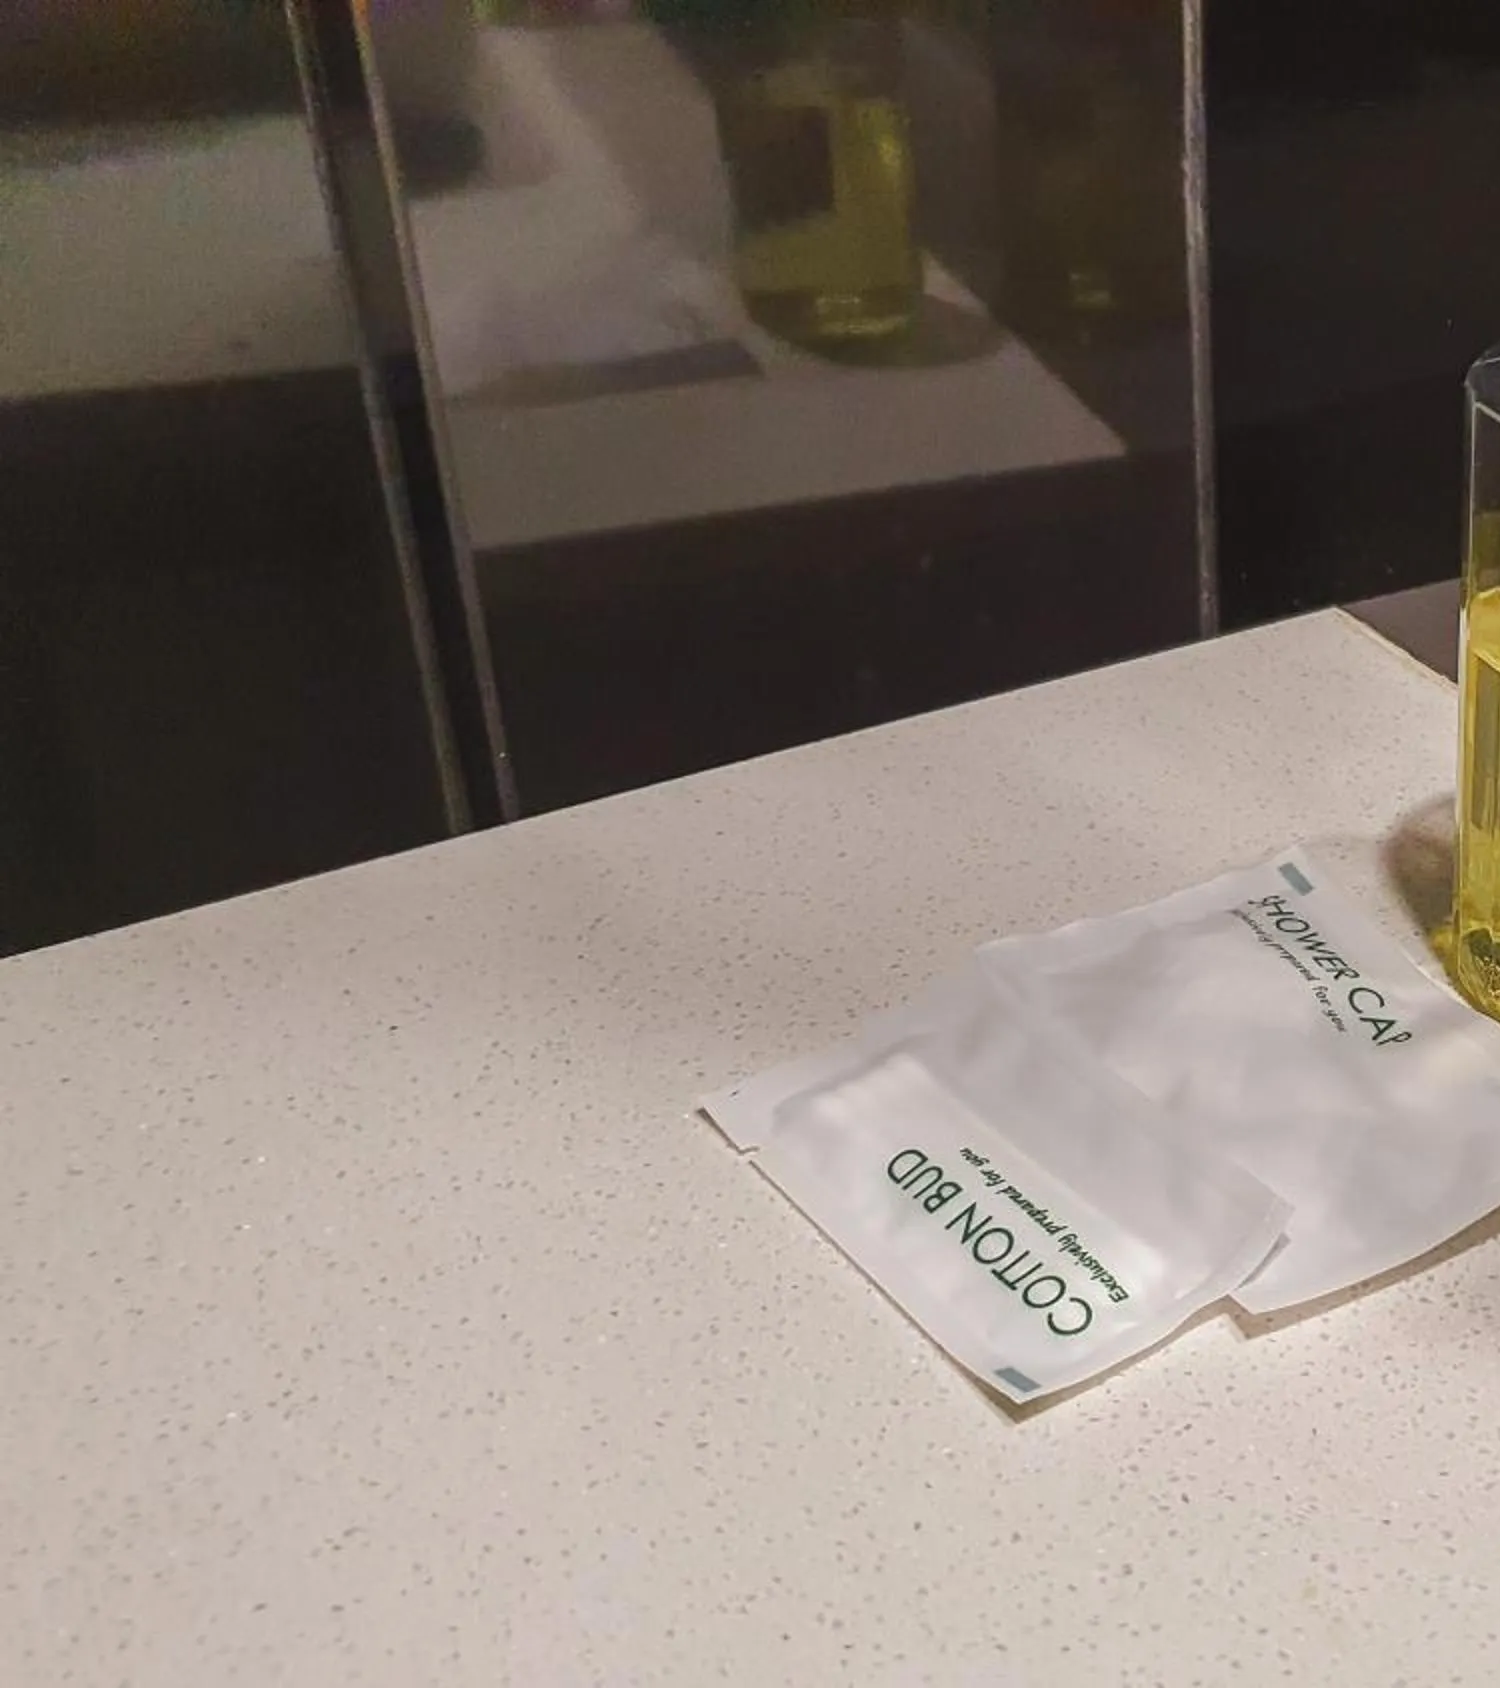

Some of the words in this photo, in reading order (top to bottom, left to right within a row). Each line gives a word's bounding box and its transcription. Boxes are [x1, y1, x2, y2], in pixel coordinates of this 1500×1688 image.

[1248, 895, 1360, 981] SHOWER
[1348, 987, 1412, 1046] CAP
[1312, 986, 1332, 1006] for
[887, 1148, 963, 1214] BUD
[960, 1147, 990, 1167] you
[980, 1169, 1006, 1187] for
[995, 1186, 1068, 1235] prepared
[944, 1202, 1093, 1336] COTTON
[1058, 1233, 1129, 1303] Exclusively
